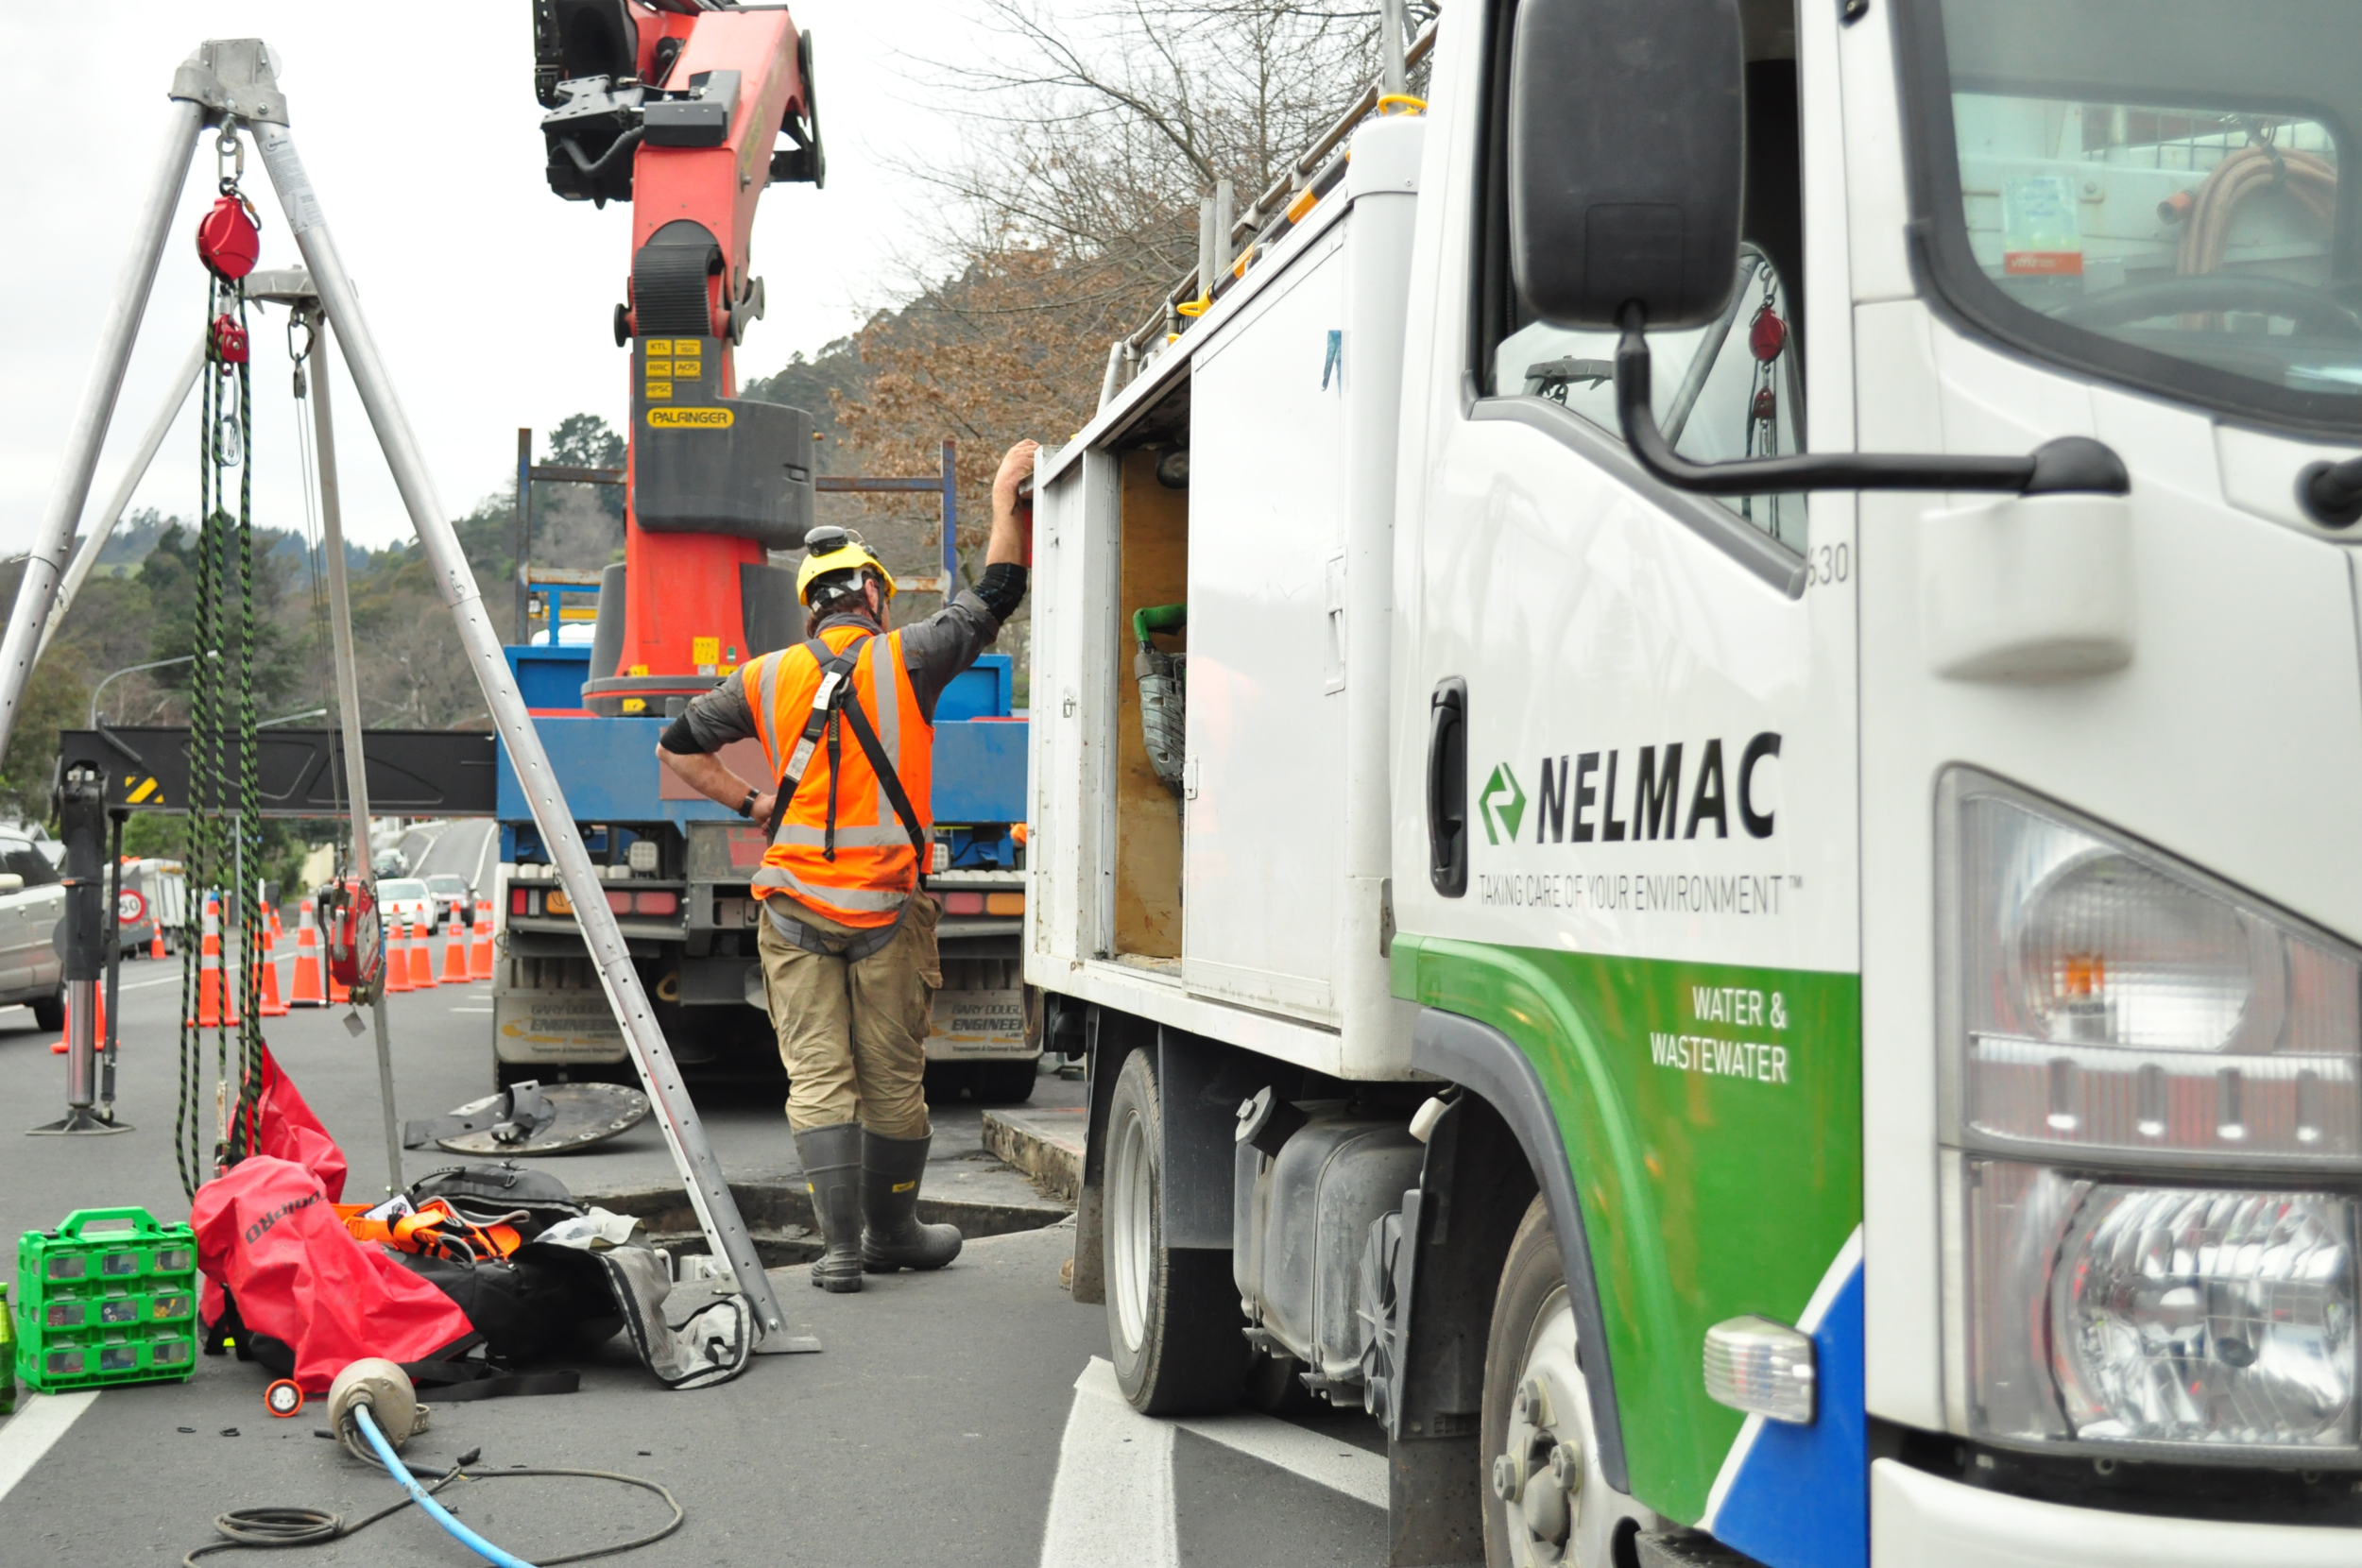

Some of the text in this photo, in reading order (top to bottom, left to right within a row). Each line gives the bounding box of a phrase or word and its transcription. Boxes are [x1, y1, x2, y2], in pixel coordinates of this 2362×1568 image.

[653, 412, 727, 424] PALFINGER
[1536, 731, 1782, 844] NELMAC
[1479, 875, 1522, 907] TAKING
[1526, 875, 1560, 908] CARE
[1566, 875, 1583, 909] OF
[1587, 875, 1628, 912] YOUR
[952, 1004, 984, 1014] GARY
[1692, 986, 1787, 1029] WATER &
[1650, 1031, 1787, 1083] WASTEWATER
